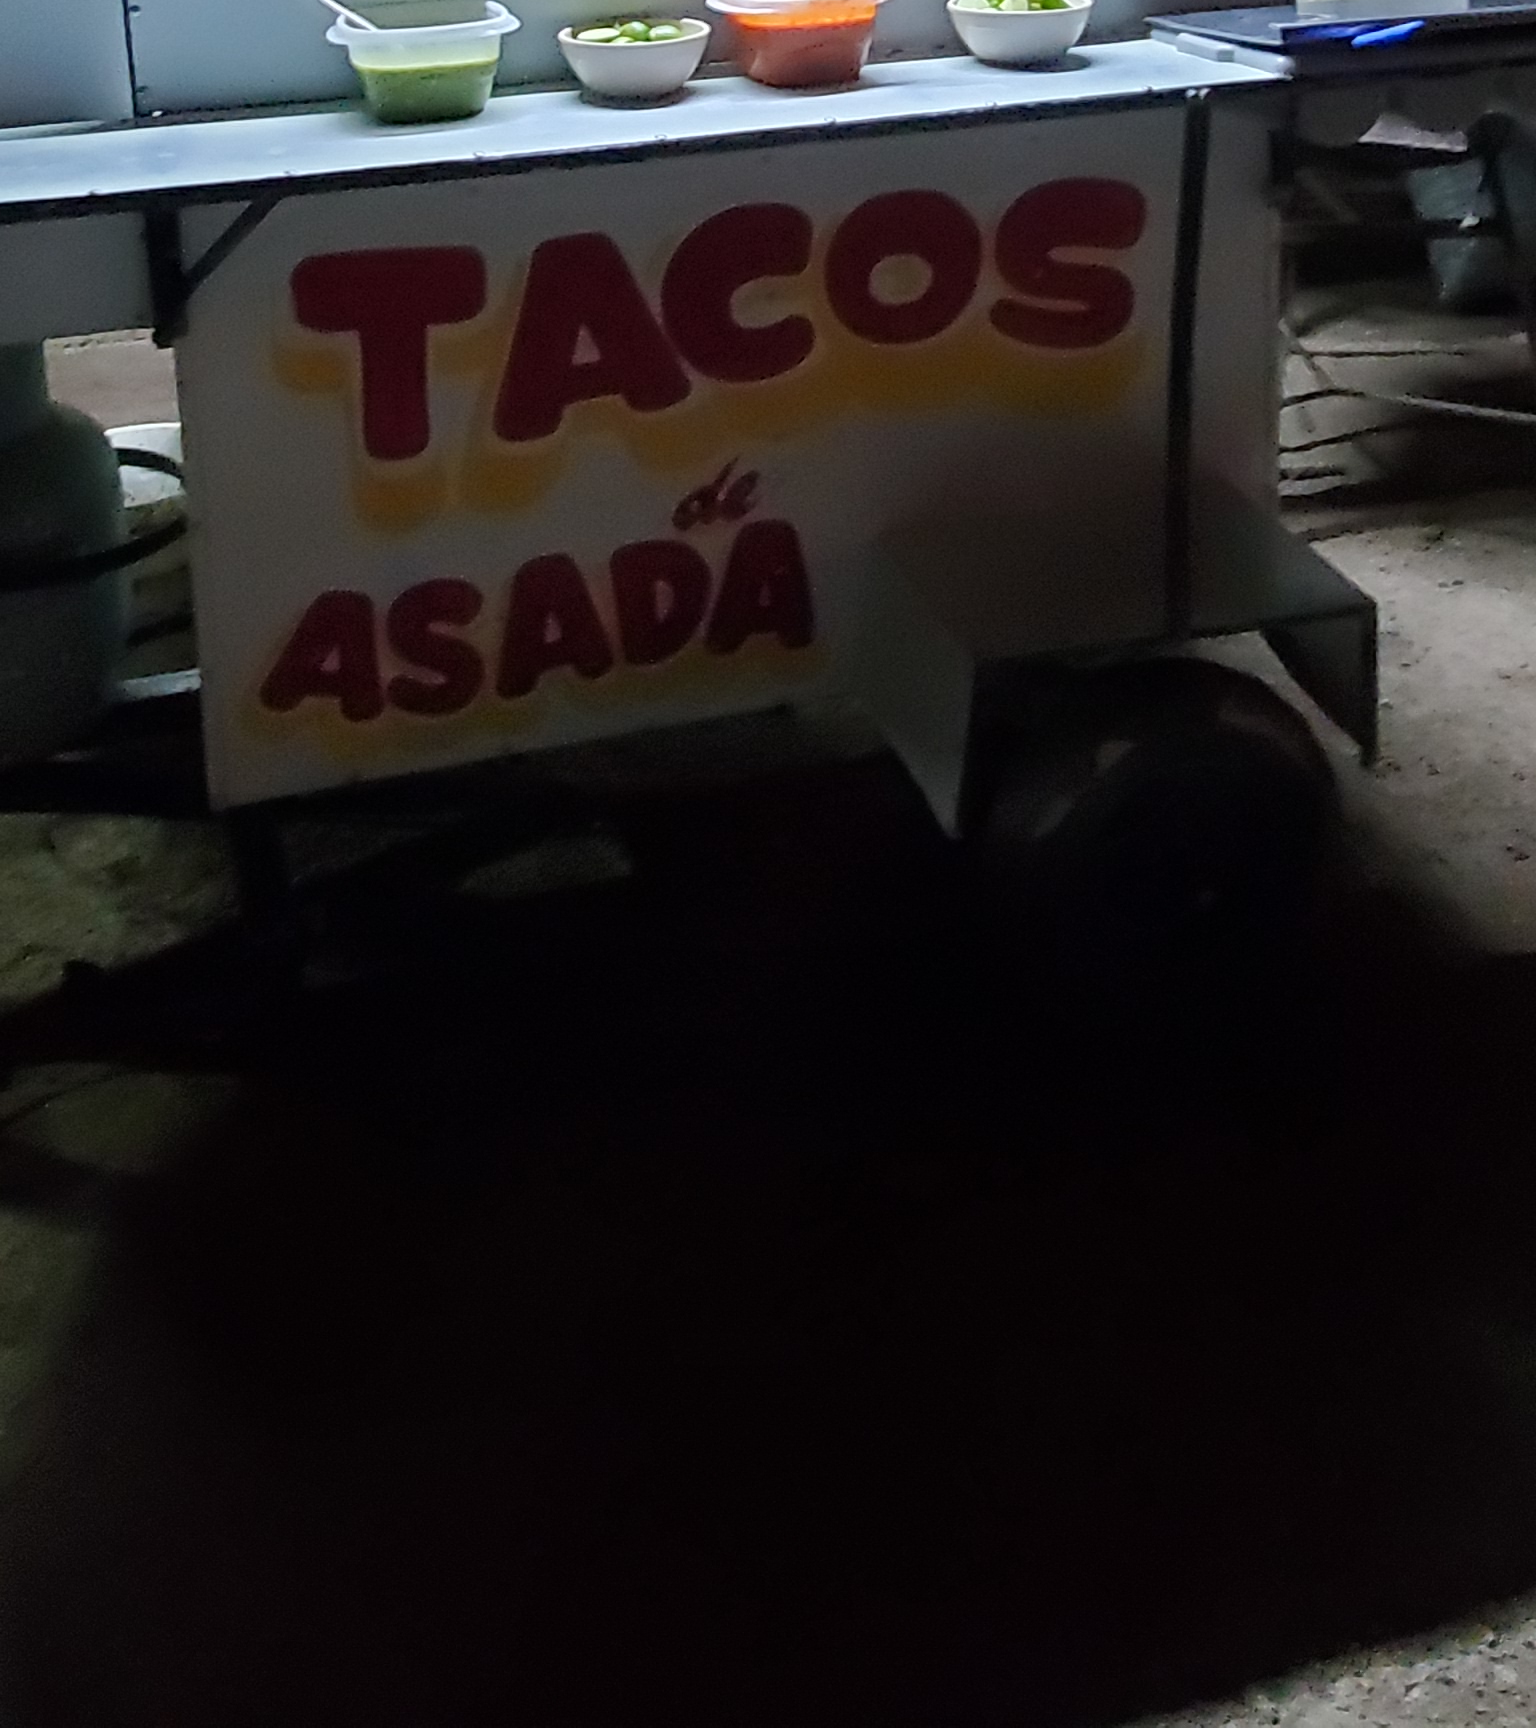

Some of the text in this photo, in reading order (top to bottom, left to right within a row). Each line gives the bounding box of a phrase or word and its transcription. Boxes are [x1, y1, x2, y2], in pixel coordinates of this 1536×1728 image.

[290, 176, 1148, 460] TACOS
[672, 456, 760, 531] de
[261, 518, 814, 722] ASADA
